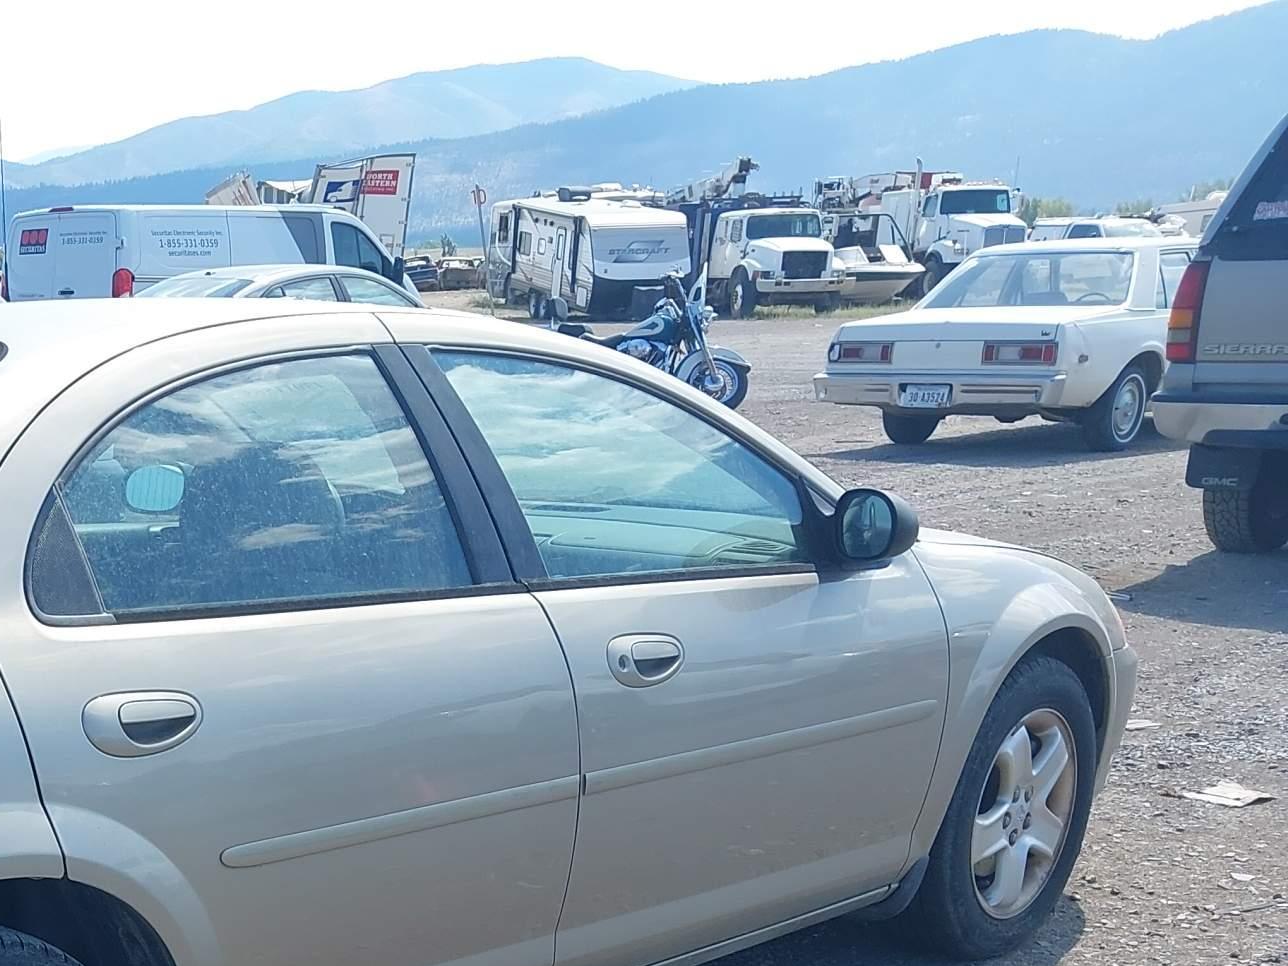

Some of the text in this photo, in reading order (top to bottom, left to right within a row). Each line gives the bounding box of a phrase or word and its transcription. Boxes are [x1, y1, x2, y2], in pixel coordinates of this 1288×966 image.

[159, 238, 219, 248] 1-855-331-0359
[608, 247, 671, 255] STARCRAFT
[1203, 343, 1288, 356] SIERRA
